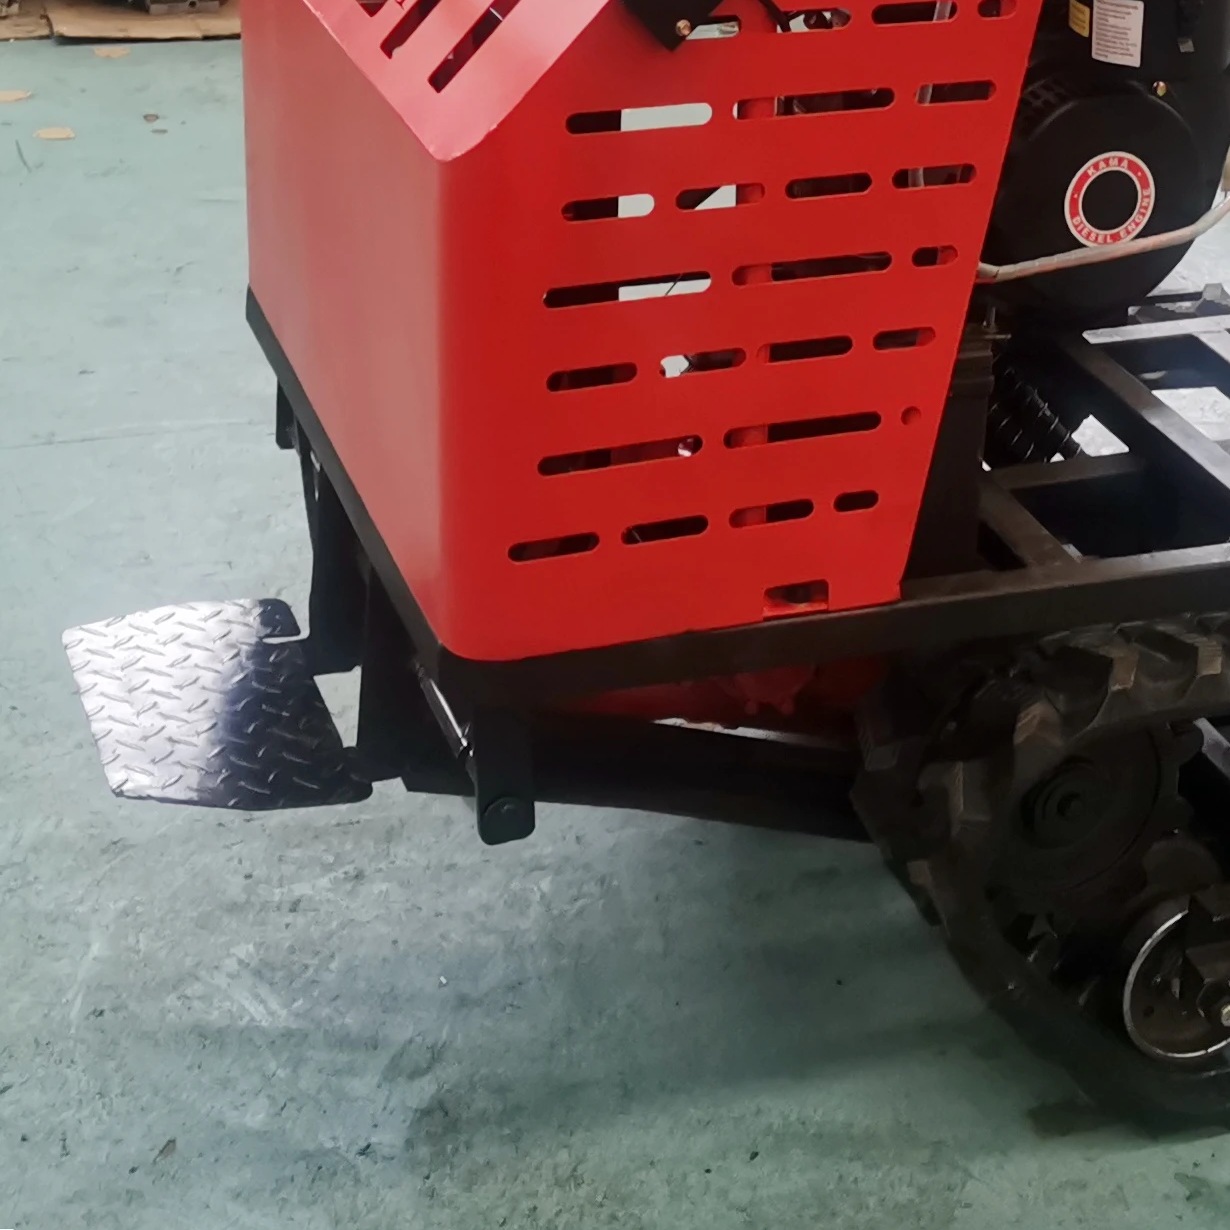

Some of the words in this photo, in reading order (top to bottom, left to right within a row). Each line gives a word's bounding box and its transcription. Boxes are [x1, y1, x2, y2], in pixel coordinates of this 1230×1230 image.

[1087, 156, 1129, 176] KAMA
[1072, 215, 1113, 244] DIESEL
[1119, 188, 1151, 239] ENGINE
